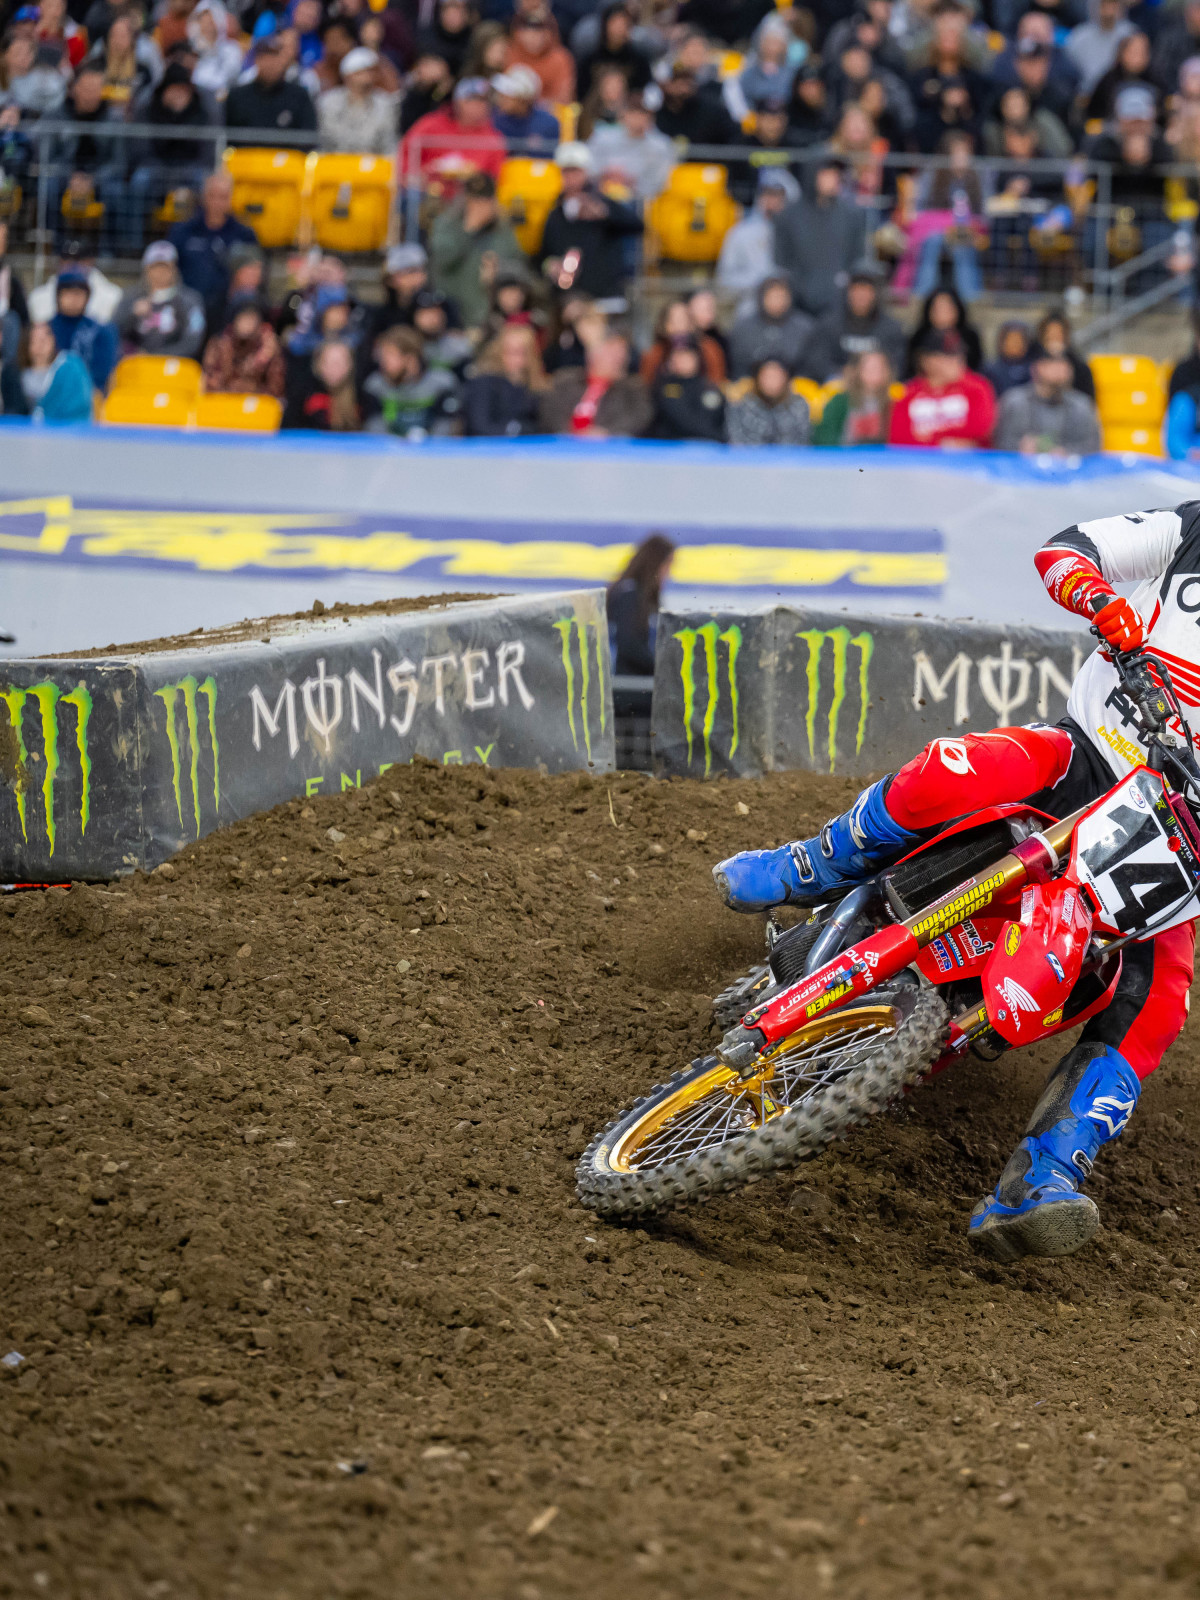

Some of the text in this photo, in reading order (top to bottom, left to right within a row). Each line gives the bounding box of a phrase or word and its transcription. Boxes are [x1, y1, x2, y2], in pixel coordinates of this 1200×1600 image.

[248, 640, 535, 758] MONSTER
[1080, 804, 1191, 934] 14
[911, 871, 1006, 938] connection
[929, 891, 993, 940] factory
[946, 932, 965, 968] CARRILLO
[779, 965, 846, 1015] POLISPORT
[995, 983, 1021, 1033] HONDA
